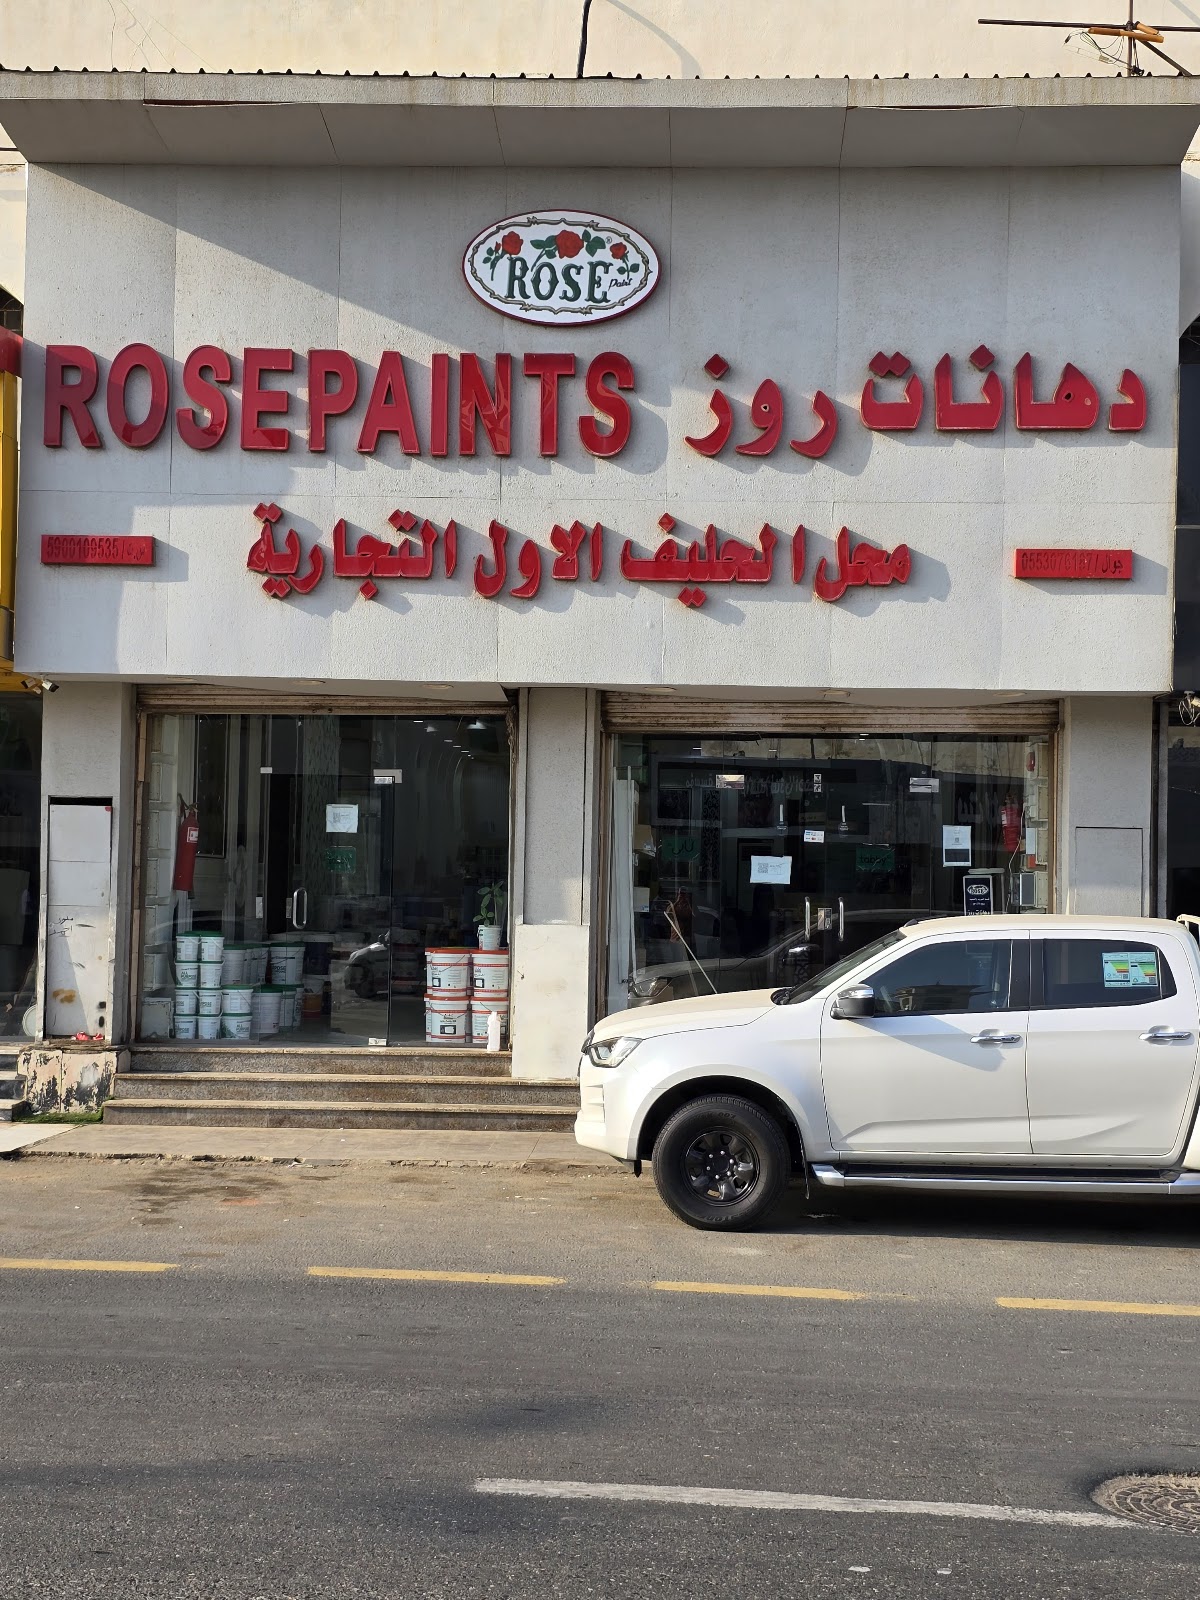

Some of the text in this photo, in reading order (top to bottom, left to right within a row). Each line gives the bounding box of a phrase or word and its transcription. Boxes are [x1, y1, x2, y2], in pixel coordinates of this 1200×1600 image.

[504, 256, 614, 303] ROSE
[44, 343, 635, 459] ROSEPAINTS
[685, 345, 1147, 459] دهانات روز
[247, 503, 911, 608] محل الحليف الاول التجارية
[859, 854, 887, 867] tabby
